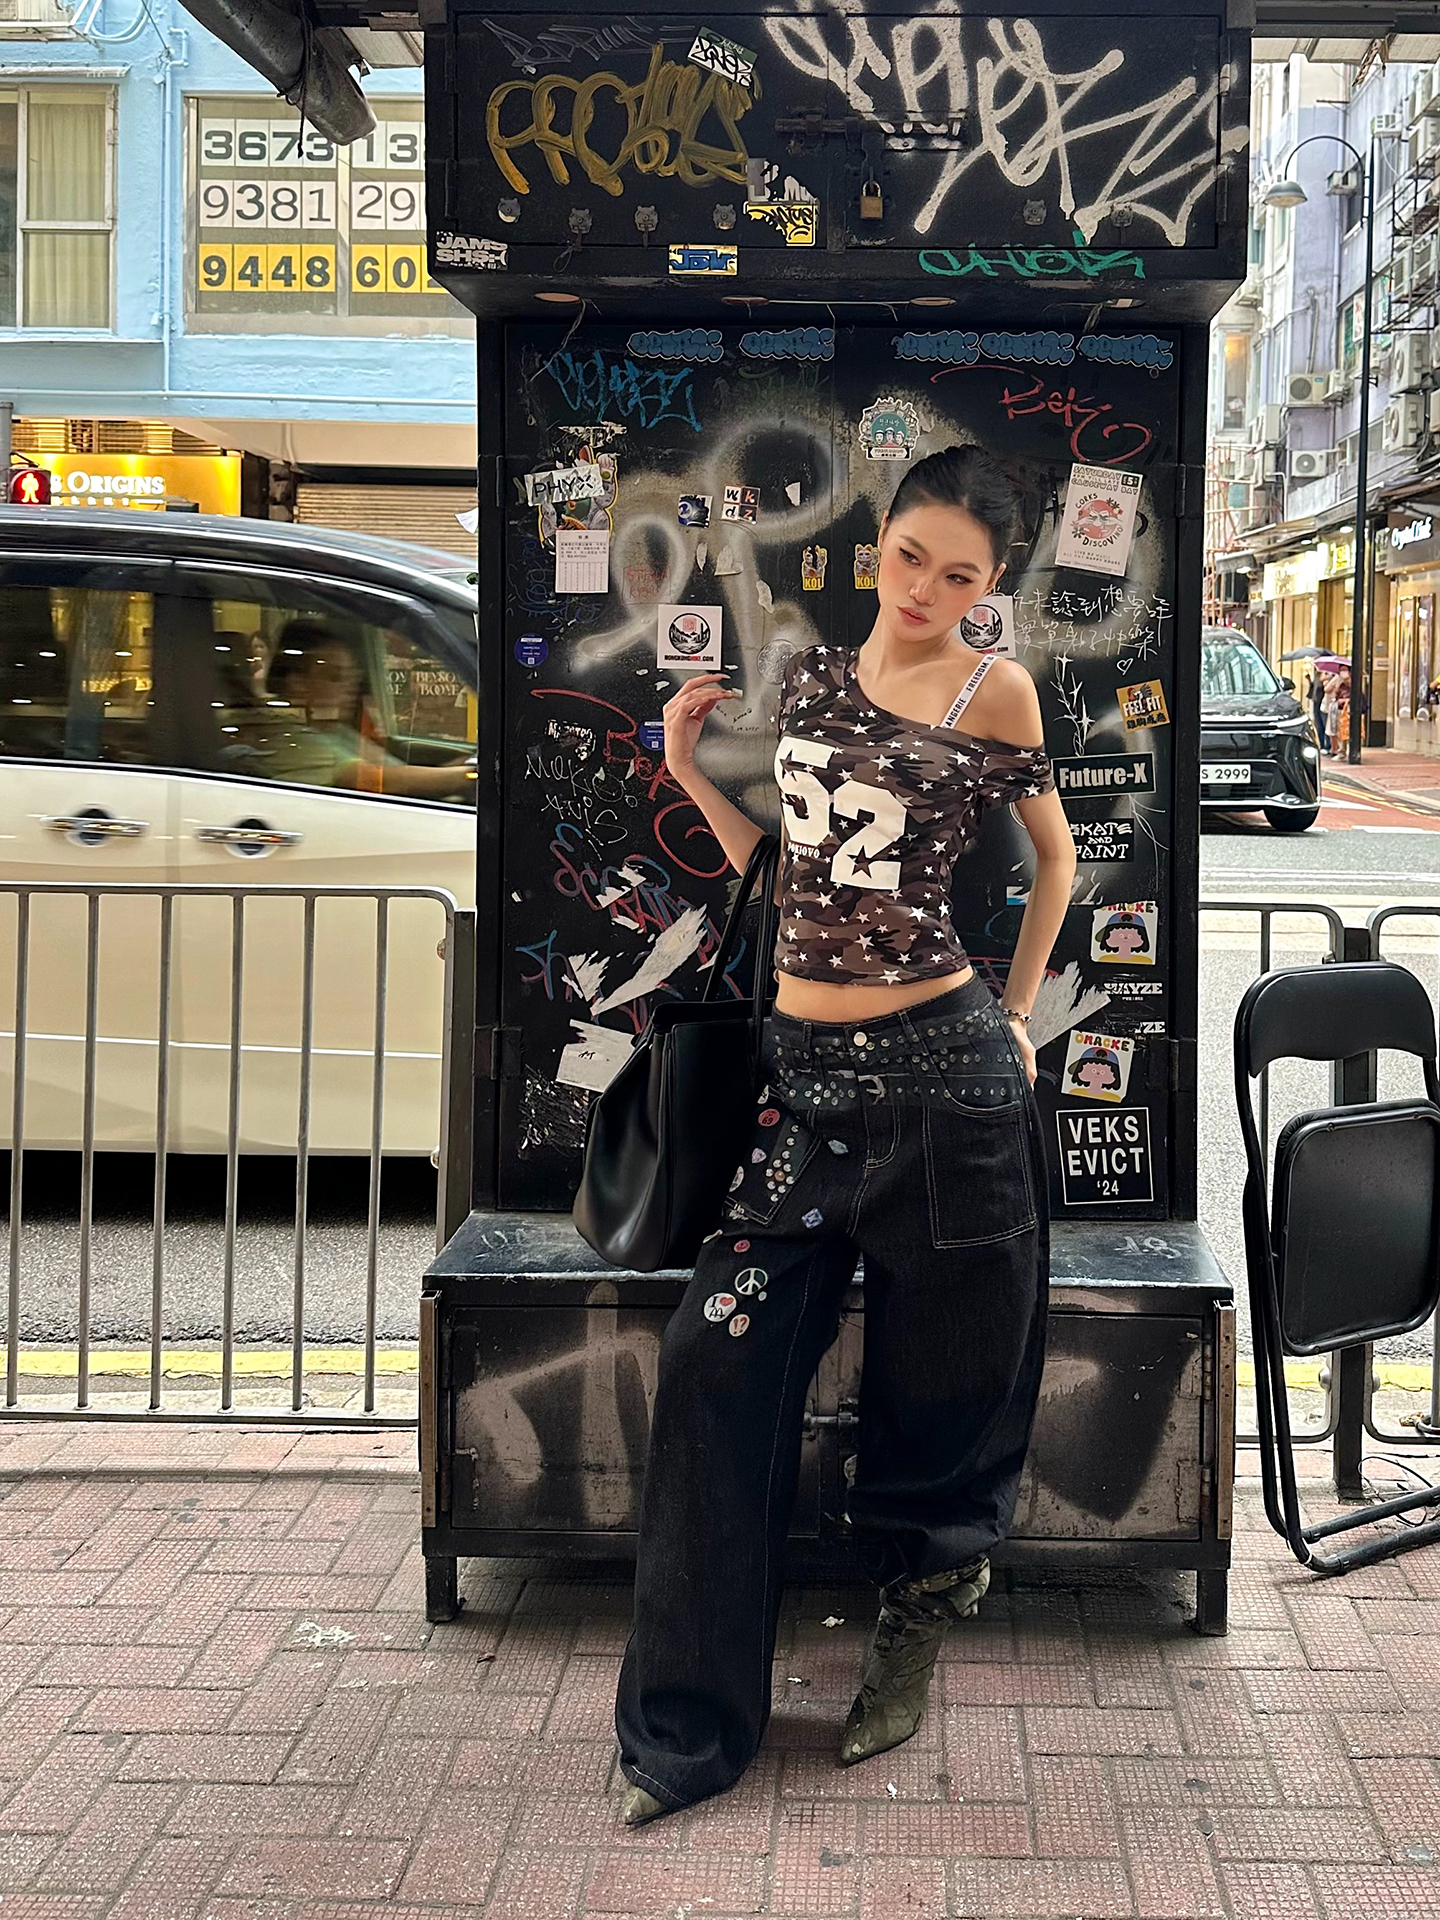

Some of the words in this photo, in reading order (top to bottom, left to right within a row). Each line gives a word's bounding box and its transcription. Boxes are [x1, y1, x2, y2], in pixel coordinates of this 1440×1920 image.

[203, 130, 335, 162] 3673
[361, 133, 426, 163] 13
[203, 183, 332, 222] 9381
[356, 185, 416, 222] 29
[436, 237, 508, 251] JAMS
[202, 255, 331, 288] 9448
[67, 471, 165, 495] ORIGINS
[1073, 466, 1122, 480] SATURDAY
[1071, 478, 1118, 491] CAUSEWAY
[1121, 486, 1139, 496] BAY
[856, 576, 876, 588] KOL
[1123, 700, 1146, 717] FEEL
[1146, 695, 1162, 711] FIT
[1059, 762, 1148, 789] Future-X
[1215, 768, 1249, 780] 2999
[1068, 1115, 1140, 1144] VEKS
[1067, 1147, 1144, 1176] EVICT
